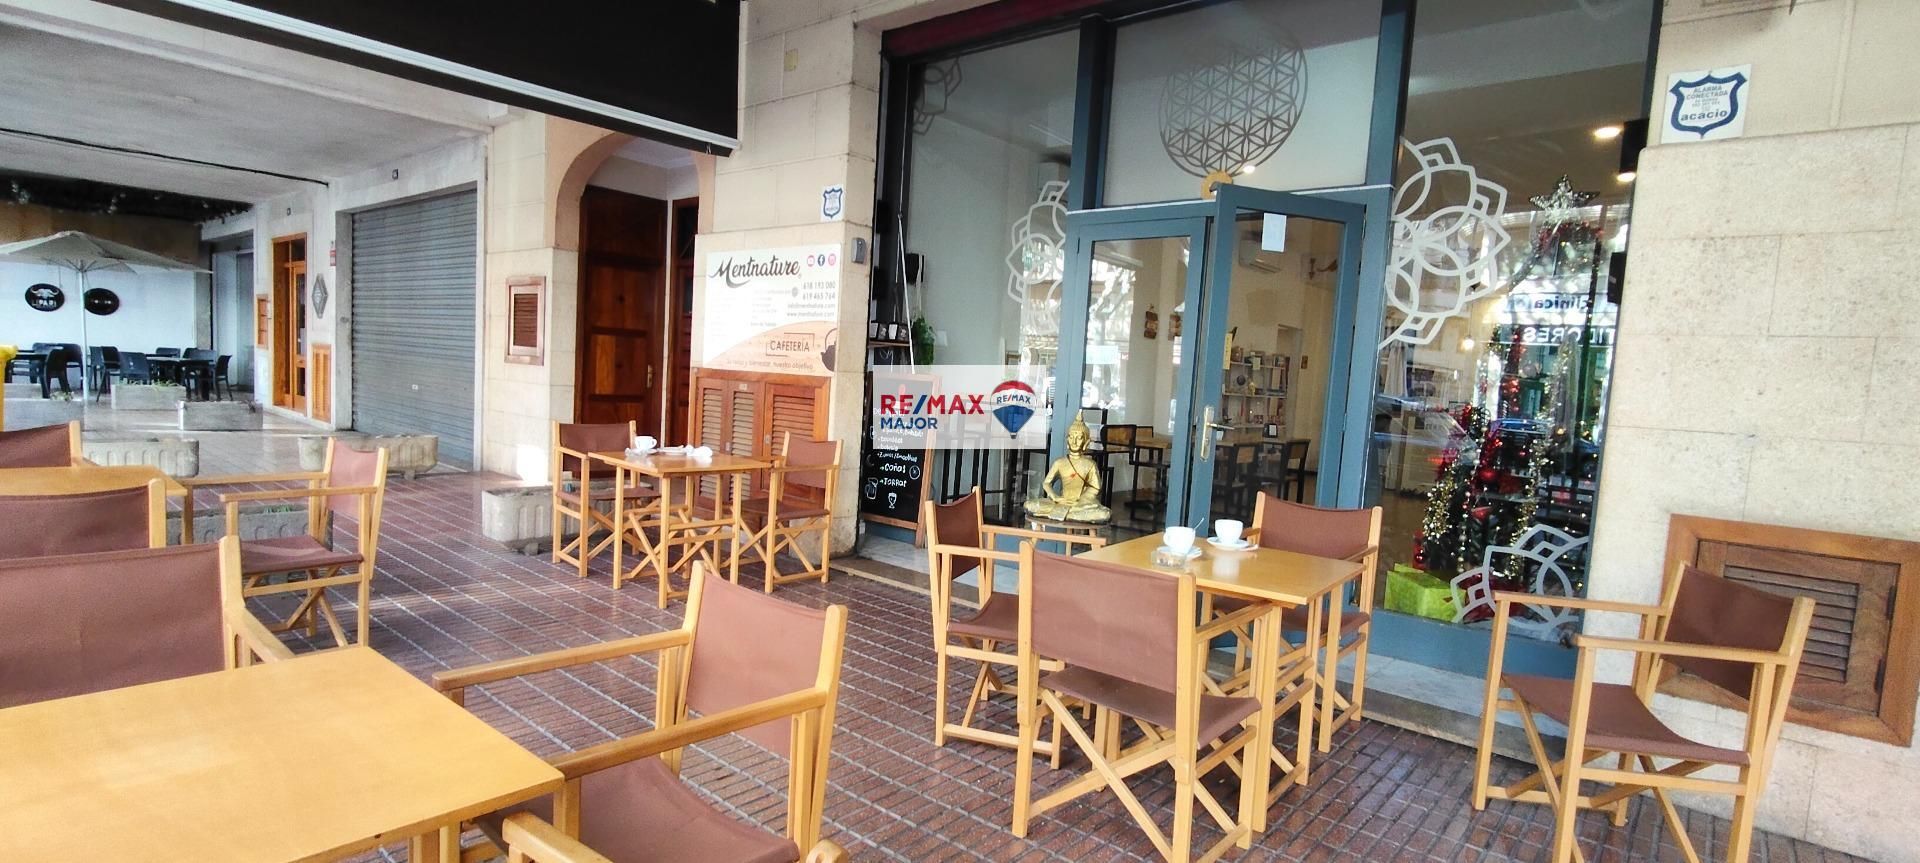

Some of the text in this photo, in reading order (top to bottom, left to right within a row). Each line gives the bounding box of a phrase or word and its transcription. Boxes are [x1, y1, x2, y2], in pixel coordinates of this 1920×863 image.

[1686, 90, 1728, 100] CONECTADA
[1681, 109, 1728, 121] acacio
[708, 254, 799, 289] Mentnature
